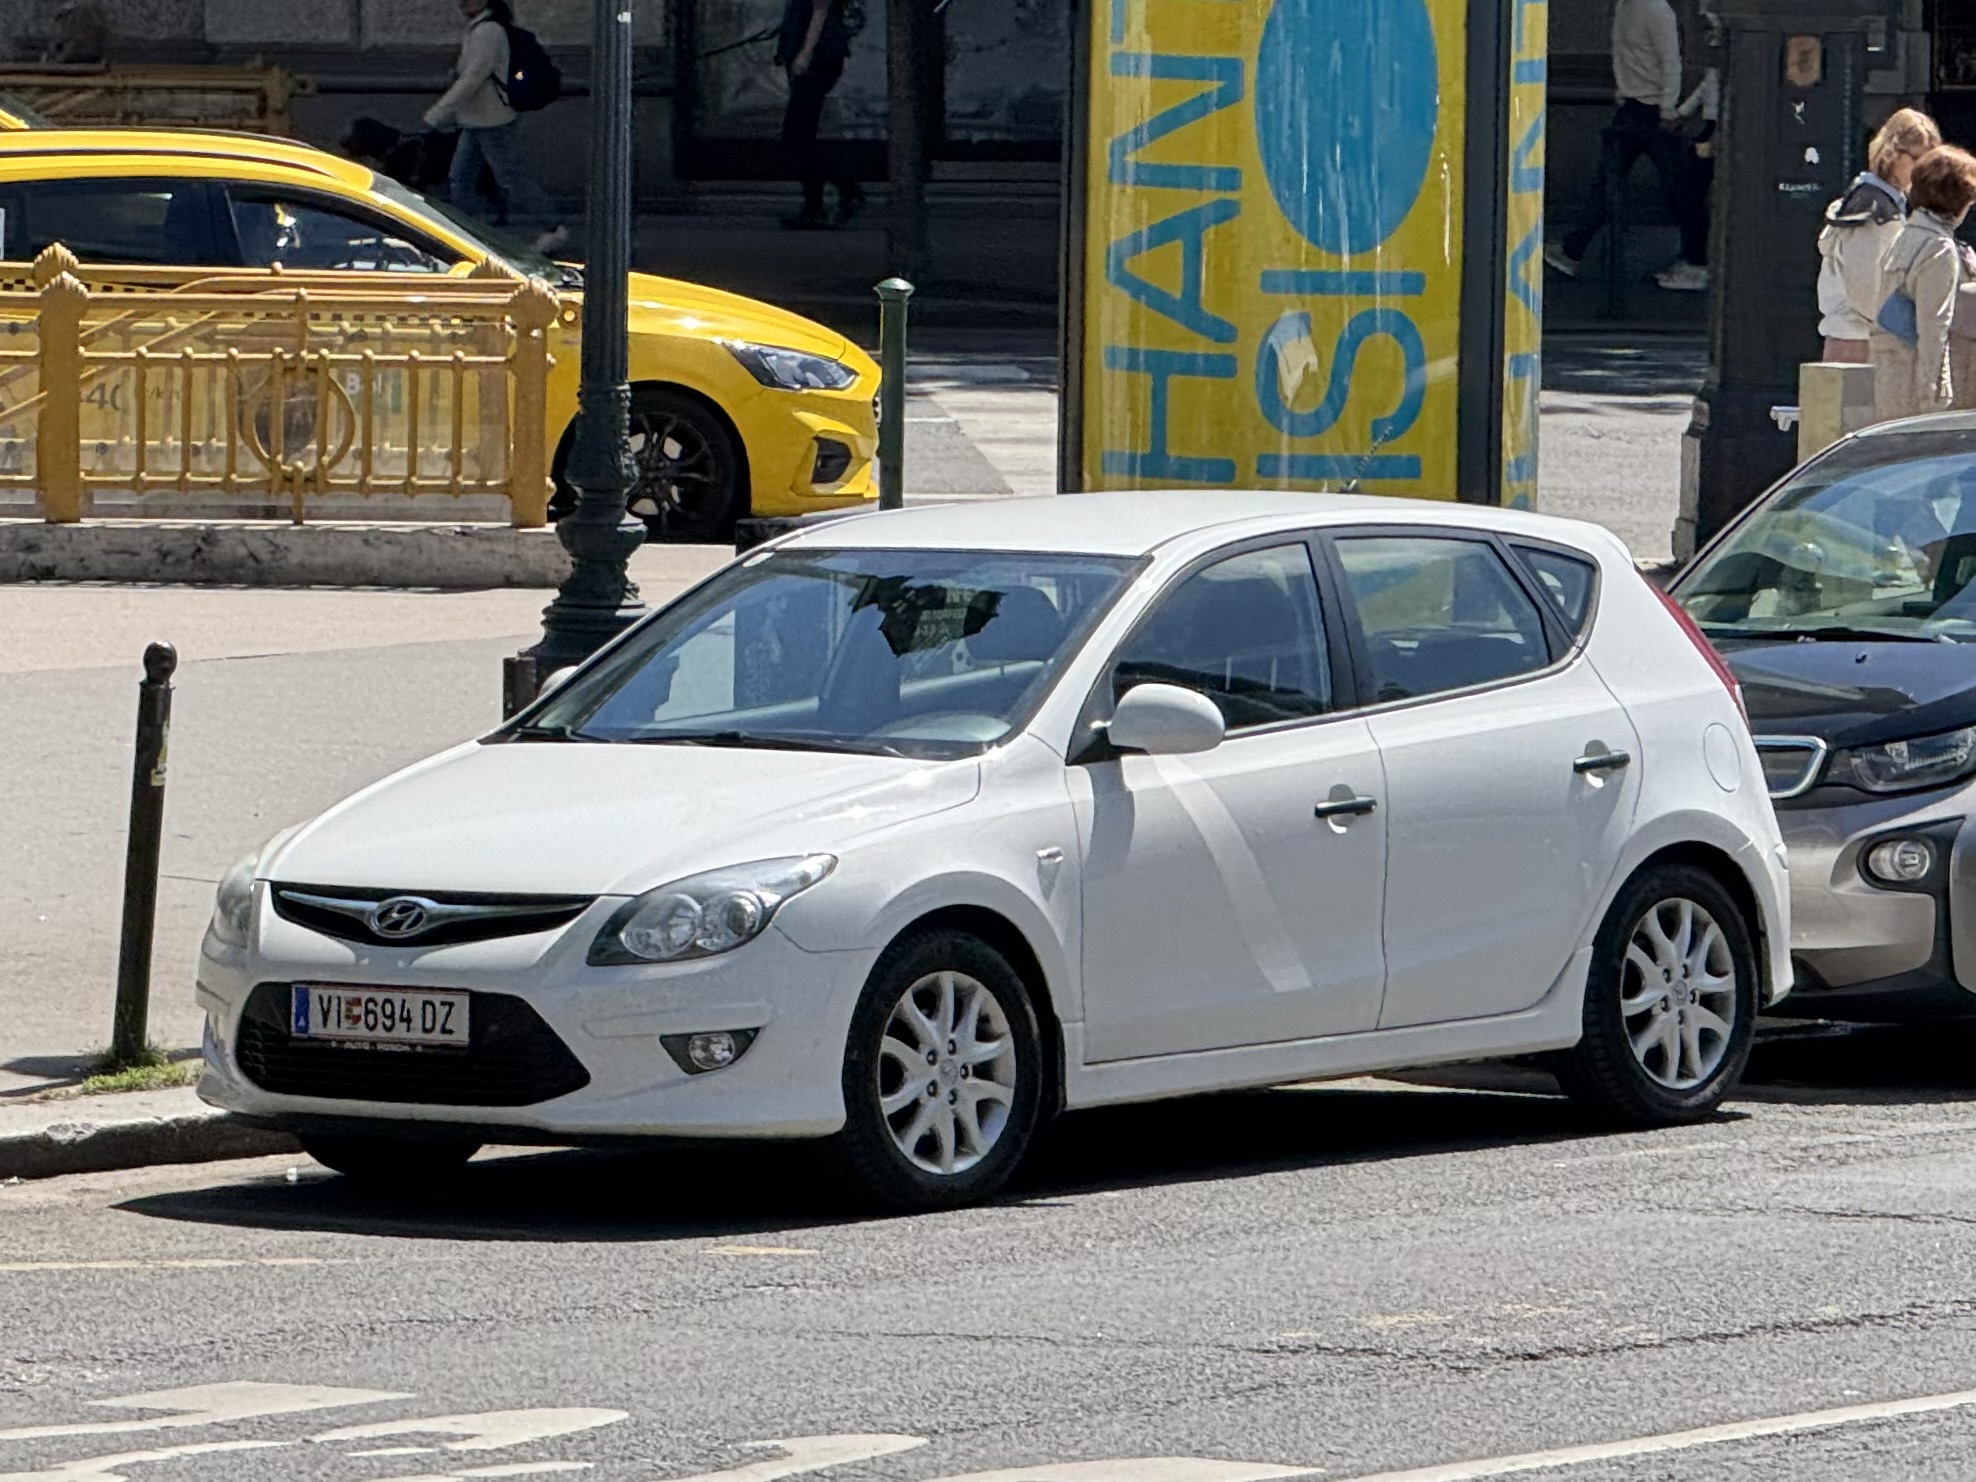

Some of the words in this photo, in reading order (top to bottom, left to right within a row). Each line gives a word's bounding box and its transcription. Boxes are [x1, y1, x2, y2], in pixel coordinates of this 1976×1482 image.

[318, 994, 342, 1029] VI
[363, 997, 413, 1033] 694
[421, 1000, 456, 1035] DZ
